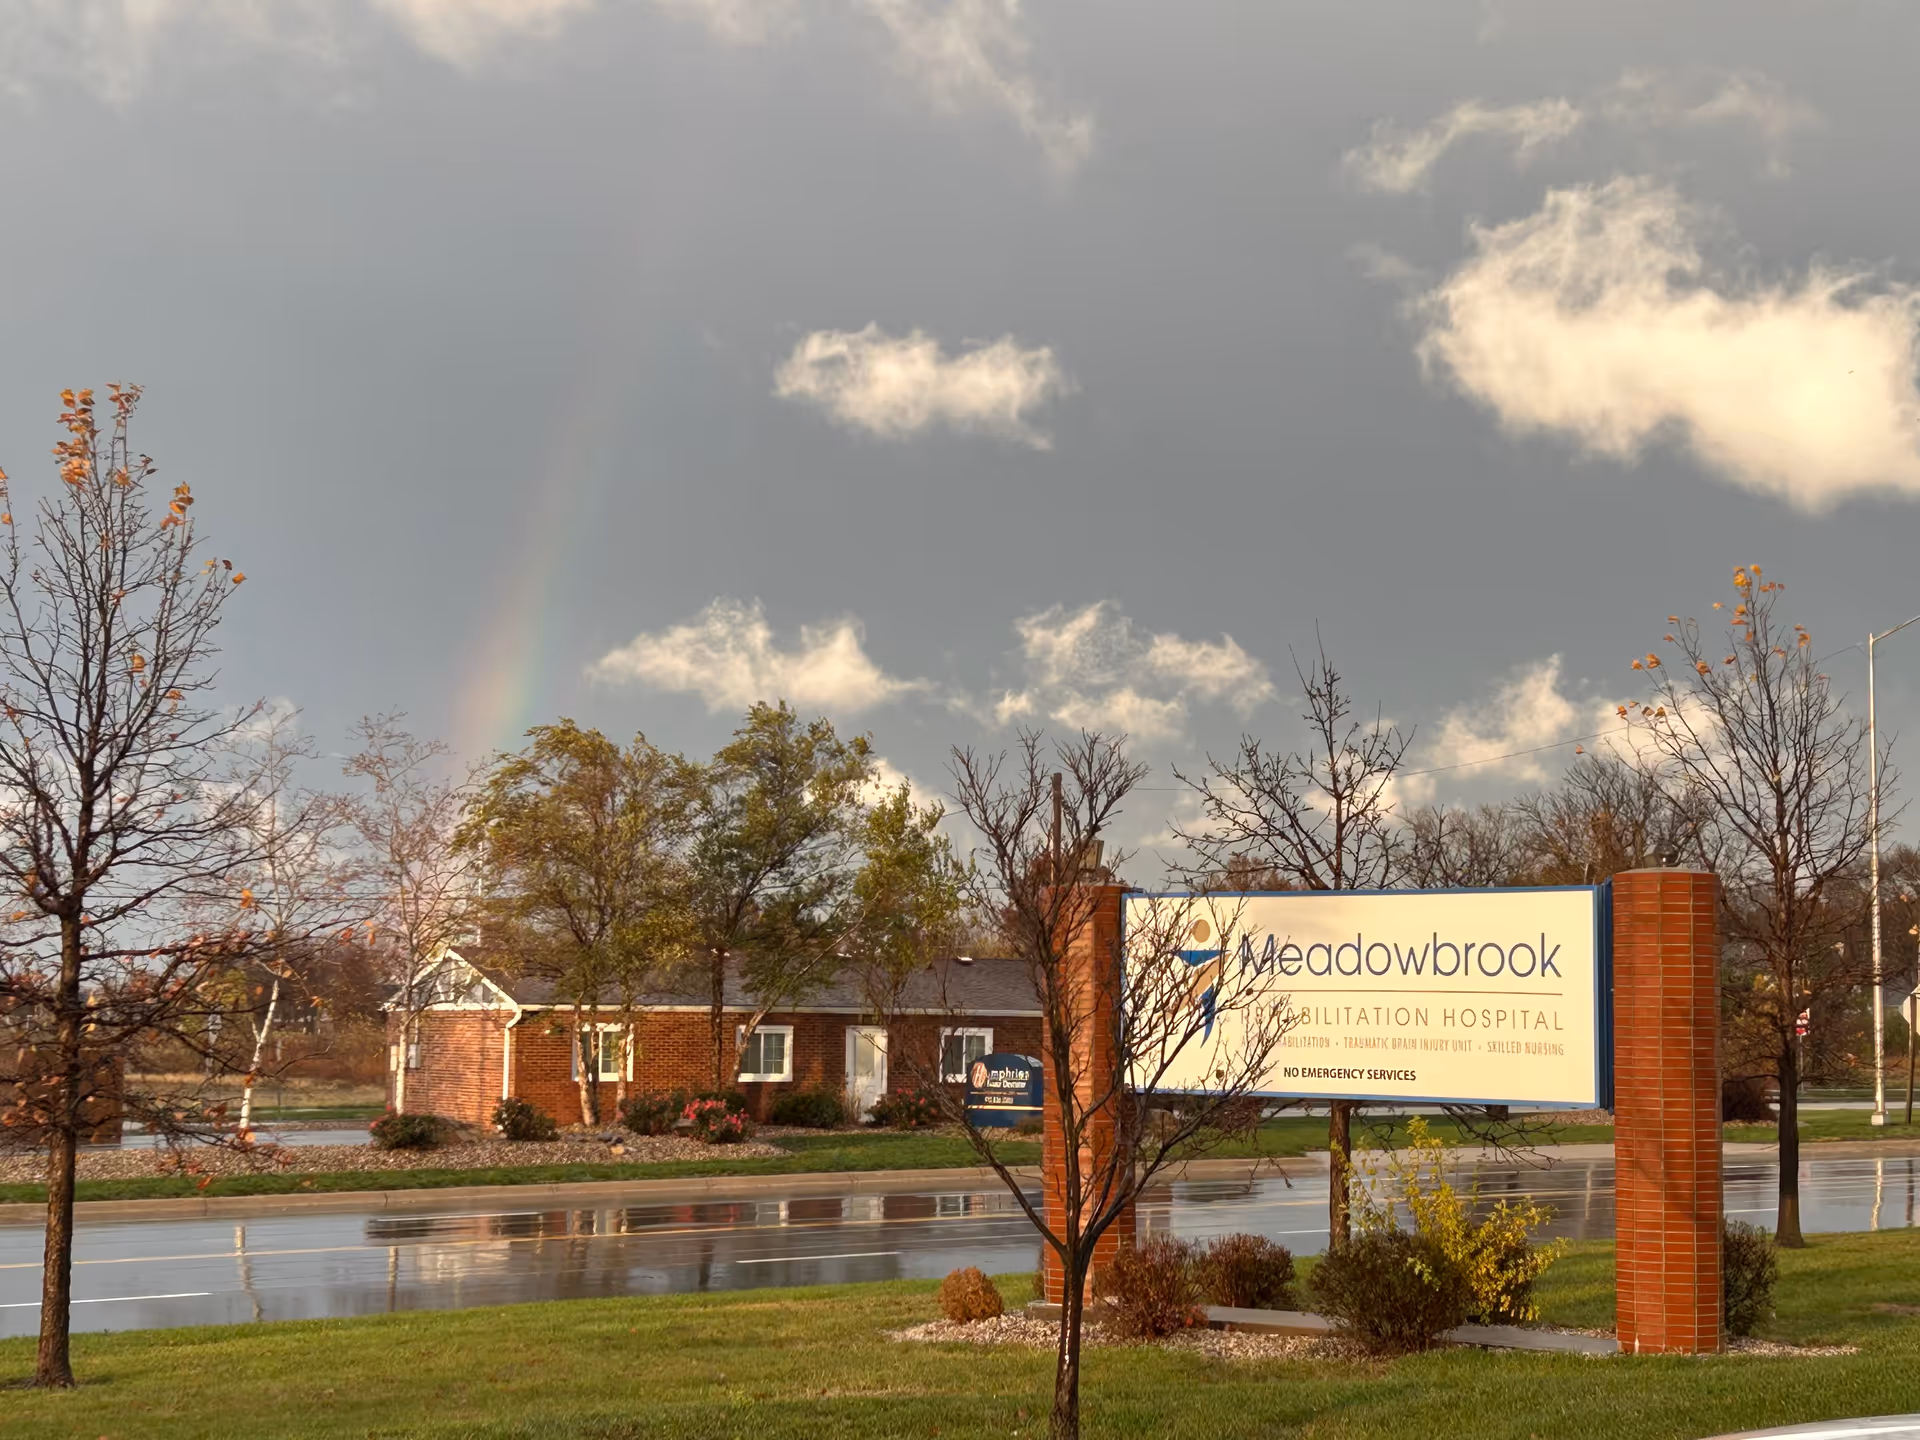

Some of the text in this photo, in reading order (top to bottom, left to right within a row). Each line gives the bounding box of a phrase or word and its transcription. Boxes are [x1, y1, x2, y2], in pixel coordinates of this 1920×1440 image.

[1240, 932, 1562, 978] Meadowbrook
[1443, 1008, 1564, 1031] HOSPITAL
[1344, 1036, 1389, 1049] TRAUMATIC
[1452, 1039, 1472, 1053] UNIT
[1487, 1040, 1521, 1055] SKILLED
[1524, 1041, 1564, 1056] NURSING
[1283, 1067, 1416, 1081] NO EMERGENCY SERVICES
